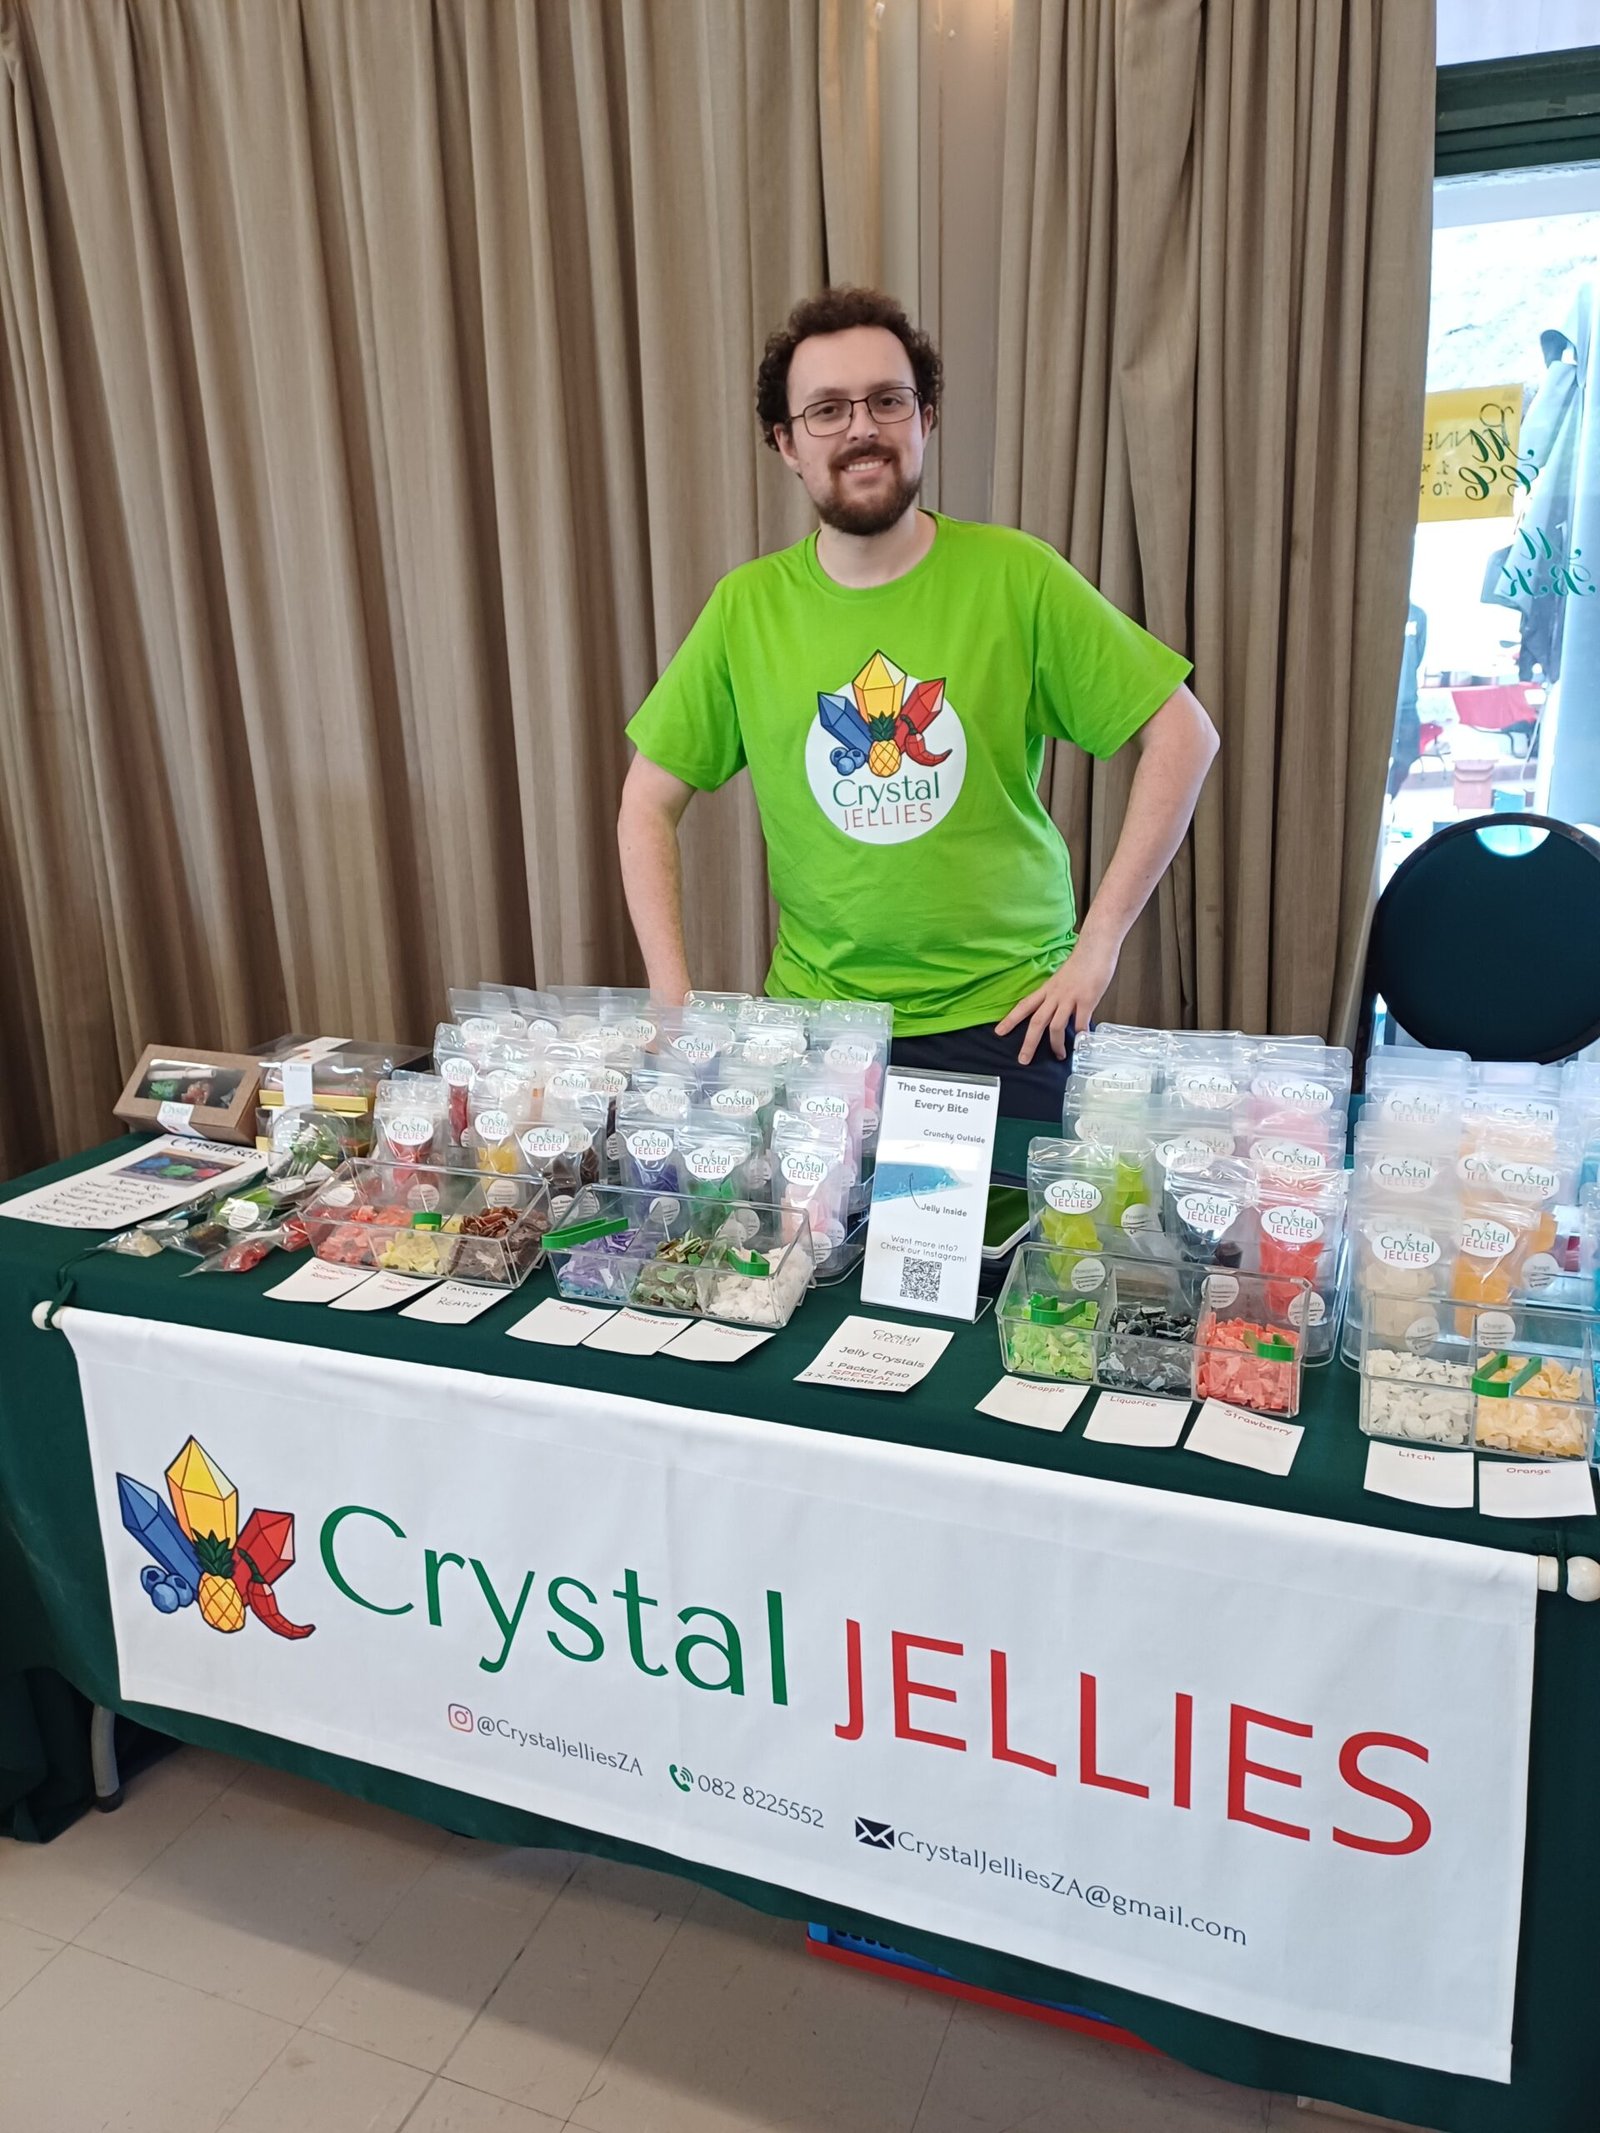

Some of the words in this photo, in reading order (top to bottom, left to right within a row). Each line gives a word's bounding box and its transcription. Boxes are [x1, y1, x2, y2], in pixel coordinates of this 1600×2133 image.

[833, 771, 940, 813] Crystal
[844, 802, 933, 831] JELLIES
[678, 1040, 714, 1052] Crystal
[898, 1082, 916, 1093] The
[918, 1083, 954, 1097] Secret
[956, 1086, 991, 1101] Inside
[1282, 1086, 1328, 1102] Crystal
[716, 1094, 755, 1107] Crystal
[806, 1101, 845, 1114] Crystal
[914, 1099, 944, 1114] Every
[947, 1102, 969, 1114] Bite
[391, 1120, 429, 1134] Crystal
[527, 1132, 565, 1146] Crystal
[632, 1135, 670, 1149] Crystal
[923, 1129, 954, 1143] Crunchy
[956, 1132, 986, 1144] Outside
[691, 1154, 731, 1168] Crystal
[787, 1157, 824, 1175] Crystal
[1273, 1151, 1320, 1167] Crystal
[1379, 1163, 1431, 1179] Crystal
[1501, 1168, 1555, 1187] Crystal
[1050, 1185, 1097, 1203] Crystal
[921, 1203, 940, 1214] Jelly
[943, 1206, 967, 1217] Inside
[1054, 1198, 1093, 1209] JELLIES
[1184, 1200, 1232, 1218] Crystal
[1187, 1210, 1226, 1226] JELLIES
[1269, 1214, 1318, 1231] Crystal
[1272, 1224, 1313, 1239] JELLIES
[880, 1241, 905, 1252] Check
[923, 1249, 967, 1262] Instagram!
[891, 1235, 912, 1244] Want
[915, 1240, 935, 1248] more
[938, 1243, 958, 1252] info?
[1380, 1235, 1435, 1254] Crystal
[1461, 1237, 1504, 1253] JELLIES
[1384, 1250, 1430, 1263] JELLIES
[558, 1304, 590, 1316] Cherry
[873, 1329, 920, 1343] Crystal
[839, 1346, 869, 1358] Jelly
[872, 1352, 926, 1369] Crystals
[831, 1369, 891, 1382] SPECIAL
[837, 1362, 878, 1375] Packet
[884, 1370, 910, 1379] R40
[827, 1375, 874, 1385] Packets
[1016, 1381, 1065, 1394] Pineapple
[1109, 1396, 1158, 1408] Liquorice
[1223, 1409, 1294, 1437] Strawberry
[1398, 1450, 1435, 1462] Litchi
[1506, 1467, 1551, 1475] Orange
[318, 1504, 790, 1707] Crystal
[834, 1617, 1432, 1857] JELLIES
[477, 1715, 643, 1777] @CrystaljelliesZA
[698, 1773, 736, 1801] 082
[742, 1786, 825, 1829] 8225552
[898, 1830, 1248, 1947] CrystalJelliesZA@gmail.com
